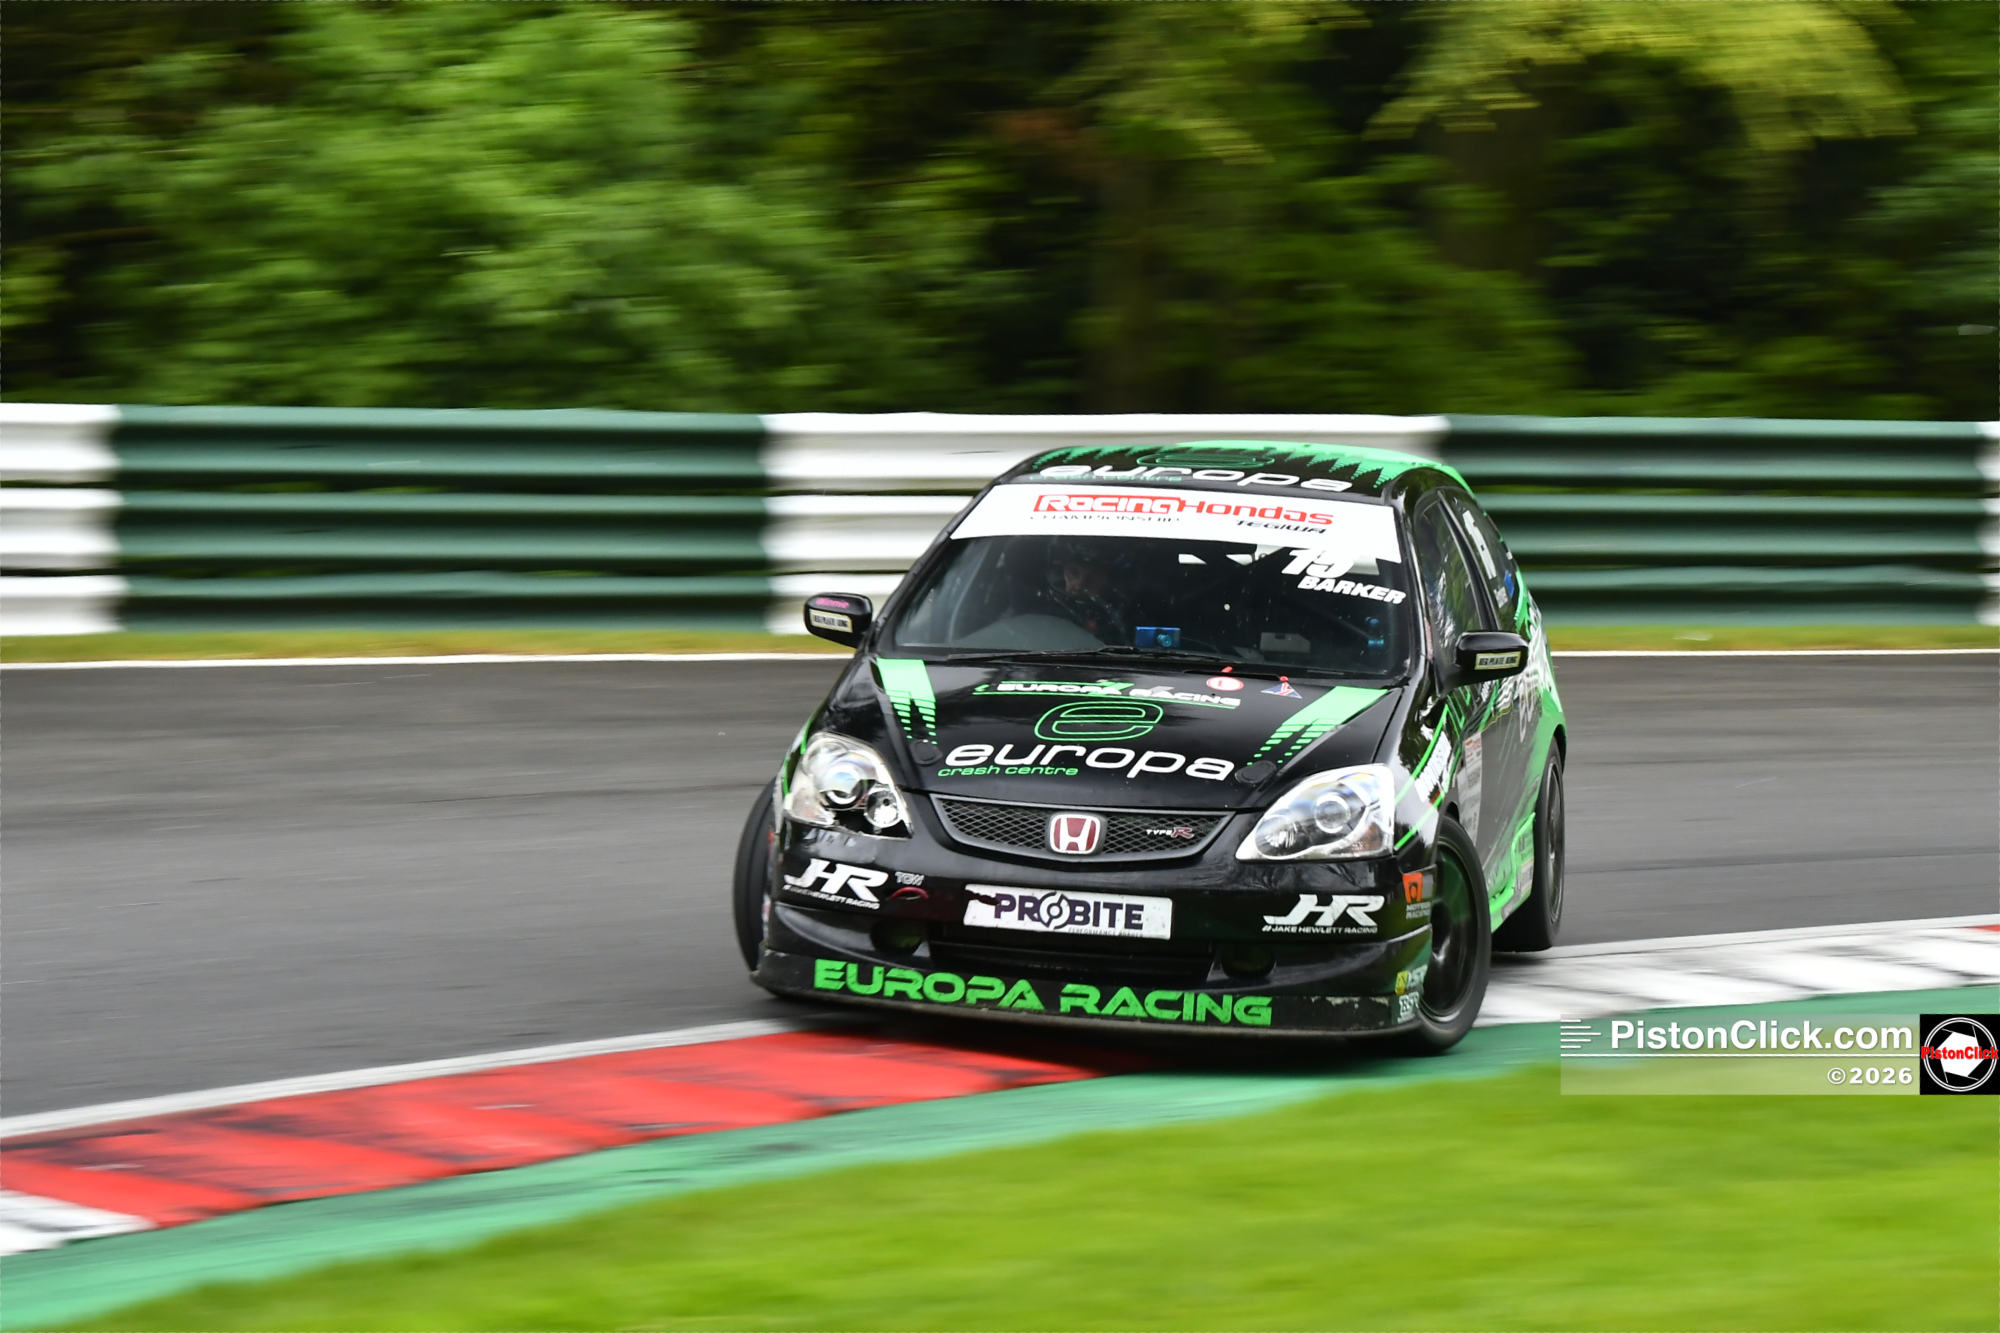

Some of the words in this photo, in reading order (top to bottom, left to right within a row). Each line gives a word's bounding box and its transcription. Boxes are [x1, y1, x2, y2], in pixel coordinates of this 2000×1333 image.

[1040, 464, 1353, 492] europa
[1297, 575, 1407, 604] BARKER
[997, 683, 1123, 696] EUROPA
[1129, 688, 1241, 707] RACING
[937, 765, 1000, 777] crash
[1004, 766, 1079, 776] centre
[944, 743, 1235, 781] europa
[845, 897, 880, 910] RACING
[994, 892, 1144, 931] PROBITE
[1299, 926, 1343, 935] HEWLETT
[1344, 926, 1378, 934] RACING
[814, 959, 1045, 1011] EUROPA
[1060, 983, 1272, 1026] RACING
